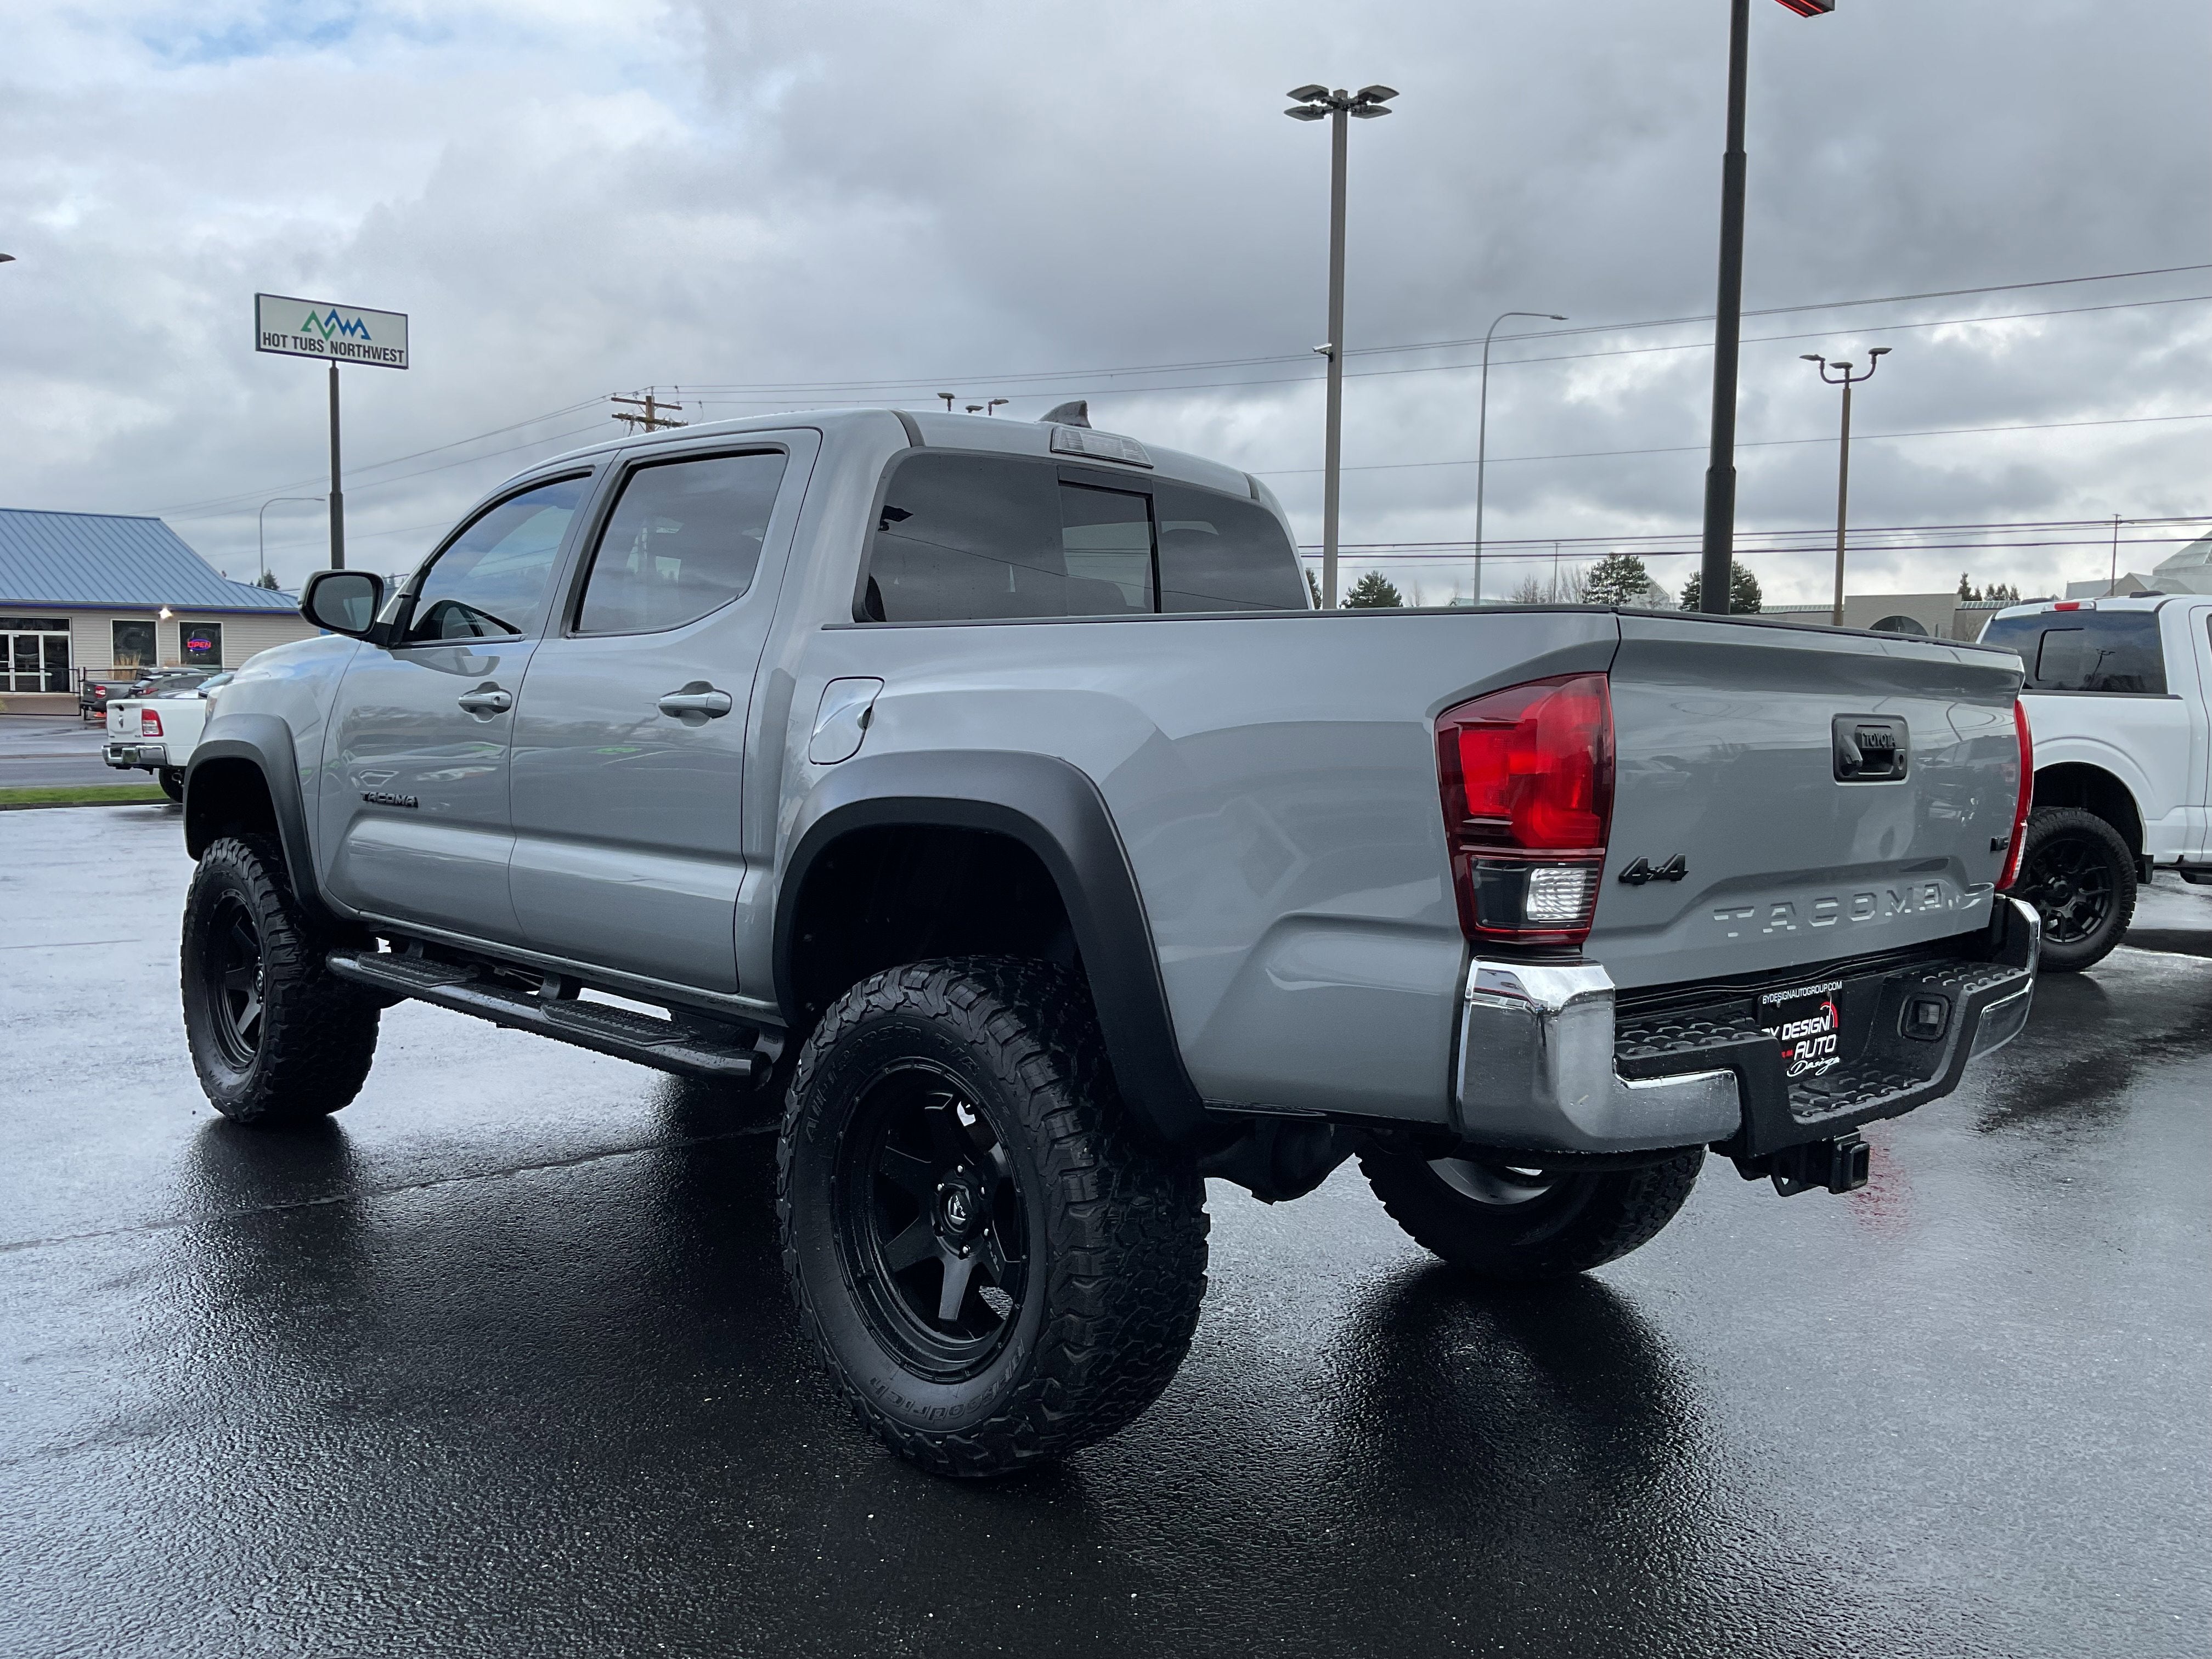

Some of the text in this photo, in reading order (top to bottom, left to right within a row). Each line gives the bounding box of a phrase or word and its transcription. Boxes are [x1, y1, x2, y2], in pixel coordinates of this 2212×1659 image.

[263, 332, 404, 363] HOT TUBS NORTHWEST
[360, 791, 419, 809] TACOMA
[1713, 882, 1943, 938] TACOMA
[1782, 1015, 1831, 1041] DESIGN
[1794, 1034, 1837, 1060] AUTO
